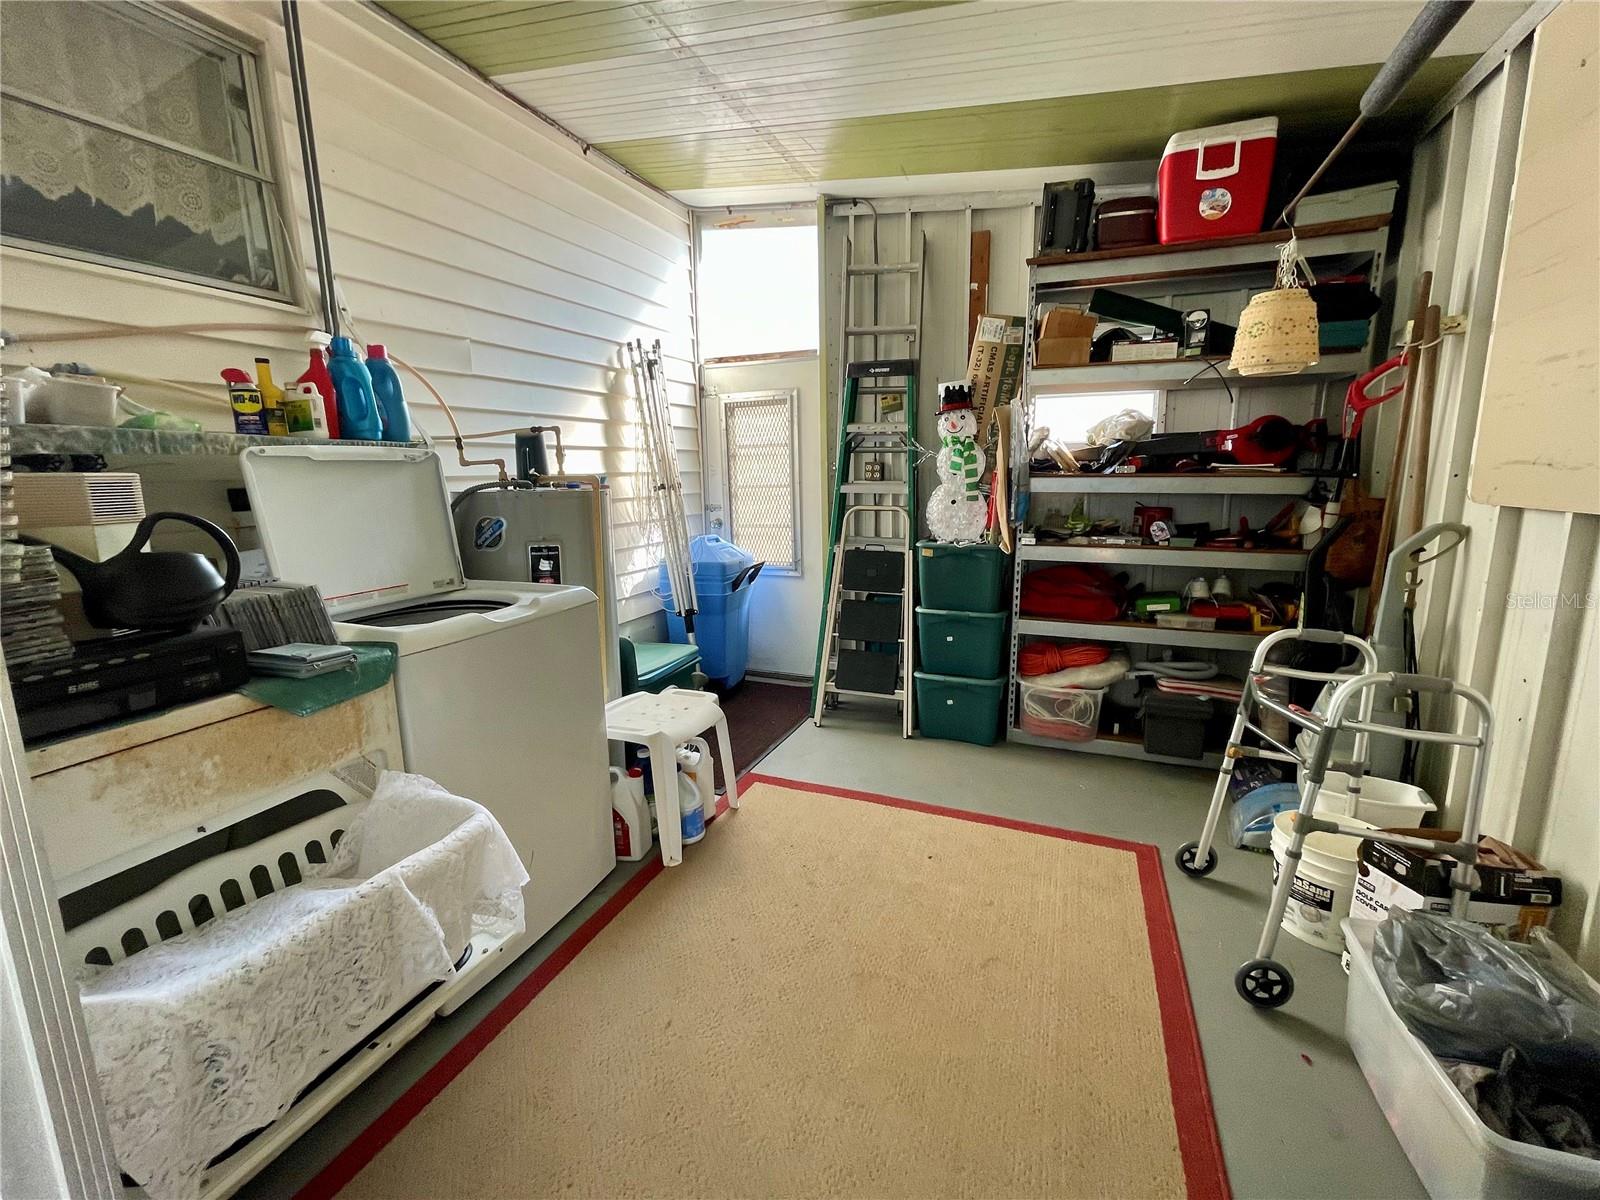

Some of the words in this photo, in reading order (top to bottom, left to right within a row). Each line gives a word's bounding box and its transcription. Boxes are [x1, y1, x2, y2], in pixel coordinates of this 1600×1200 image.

[986, 346, 998, 373] CMAS
[232, 394, 260, 404] WD-40
[1356, 889, 1374, 902] GOLF
[1355, 895, 1378, 913] COVER
